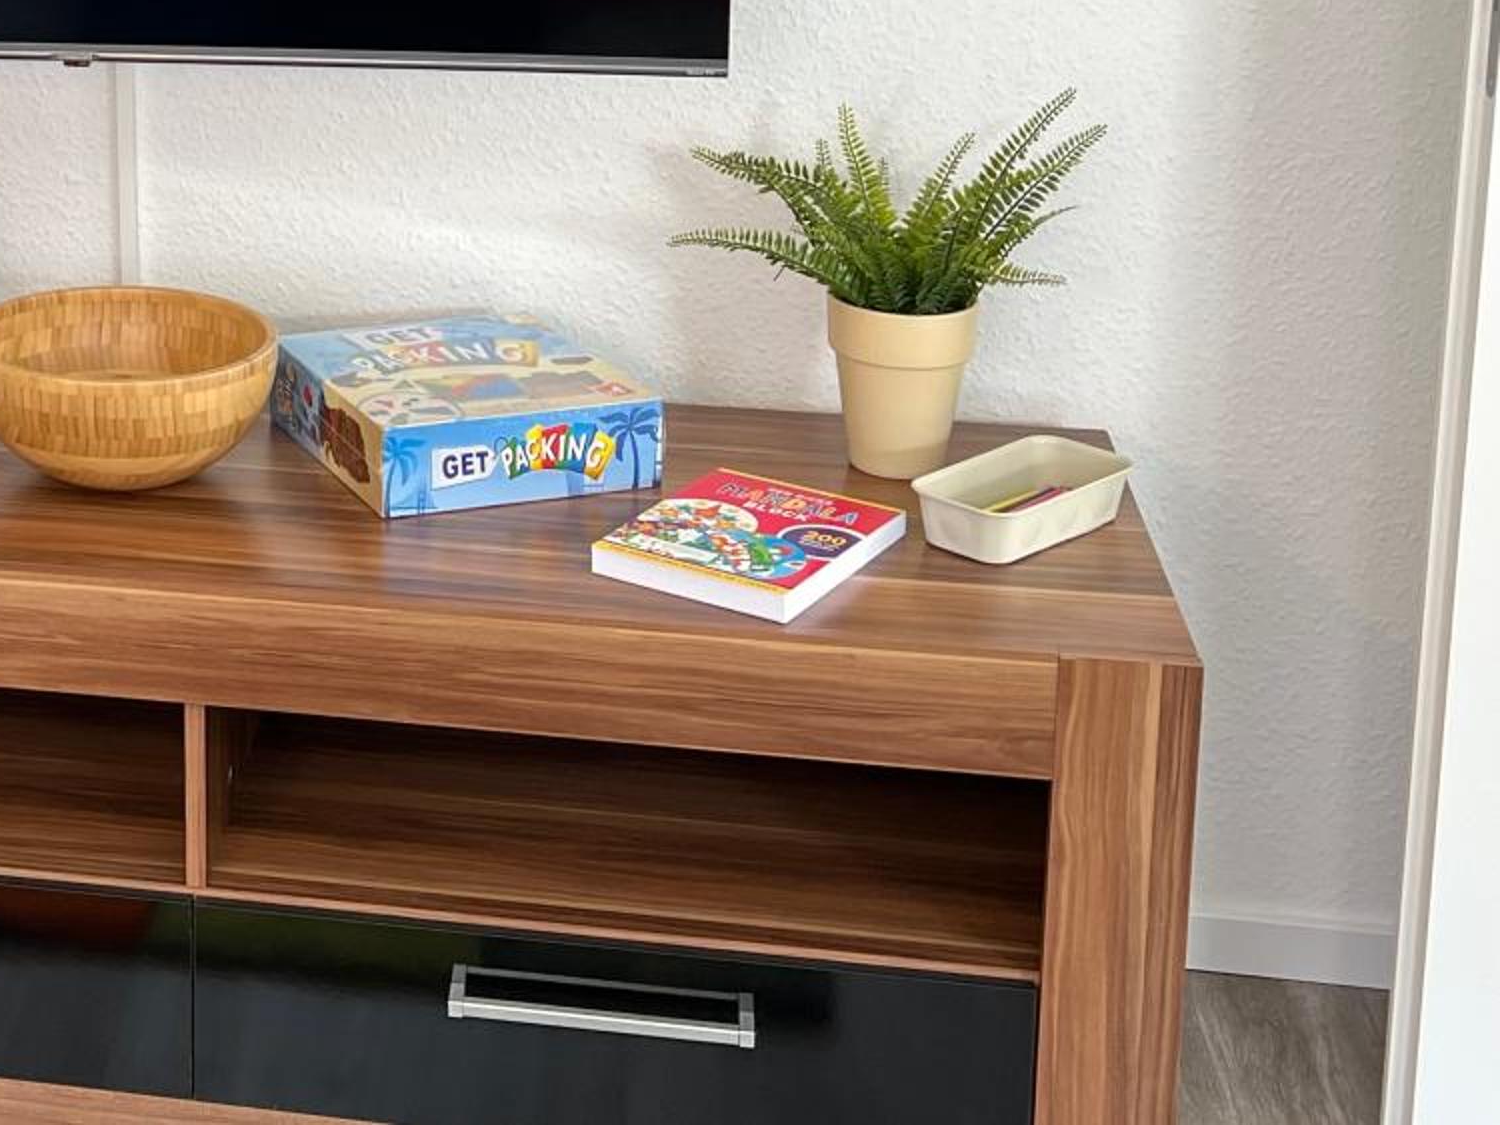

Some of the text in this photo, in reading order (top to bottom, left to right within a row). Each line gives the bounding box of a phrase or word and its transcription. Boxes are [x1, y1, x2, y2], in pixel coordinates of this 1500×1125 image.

[365, 326, 432, 345] GET
[351, 340, 534, 371] PACKING
[442, 432, 605, 479] GET PACKING
